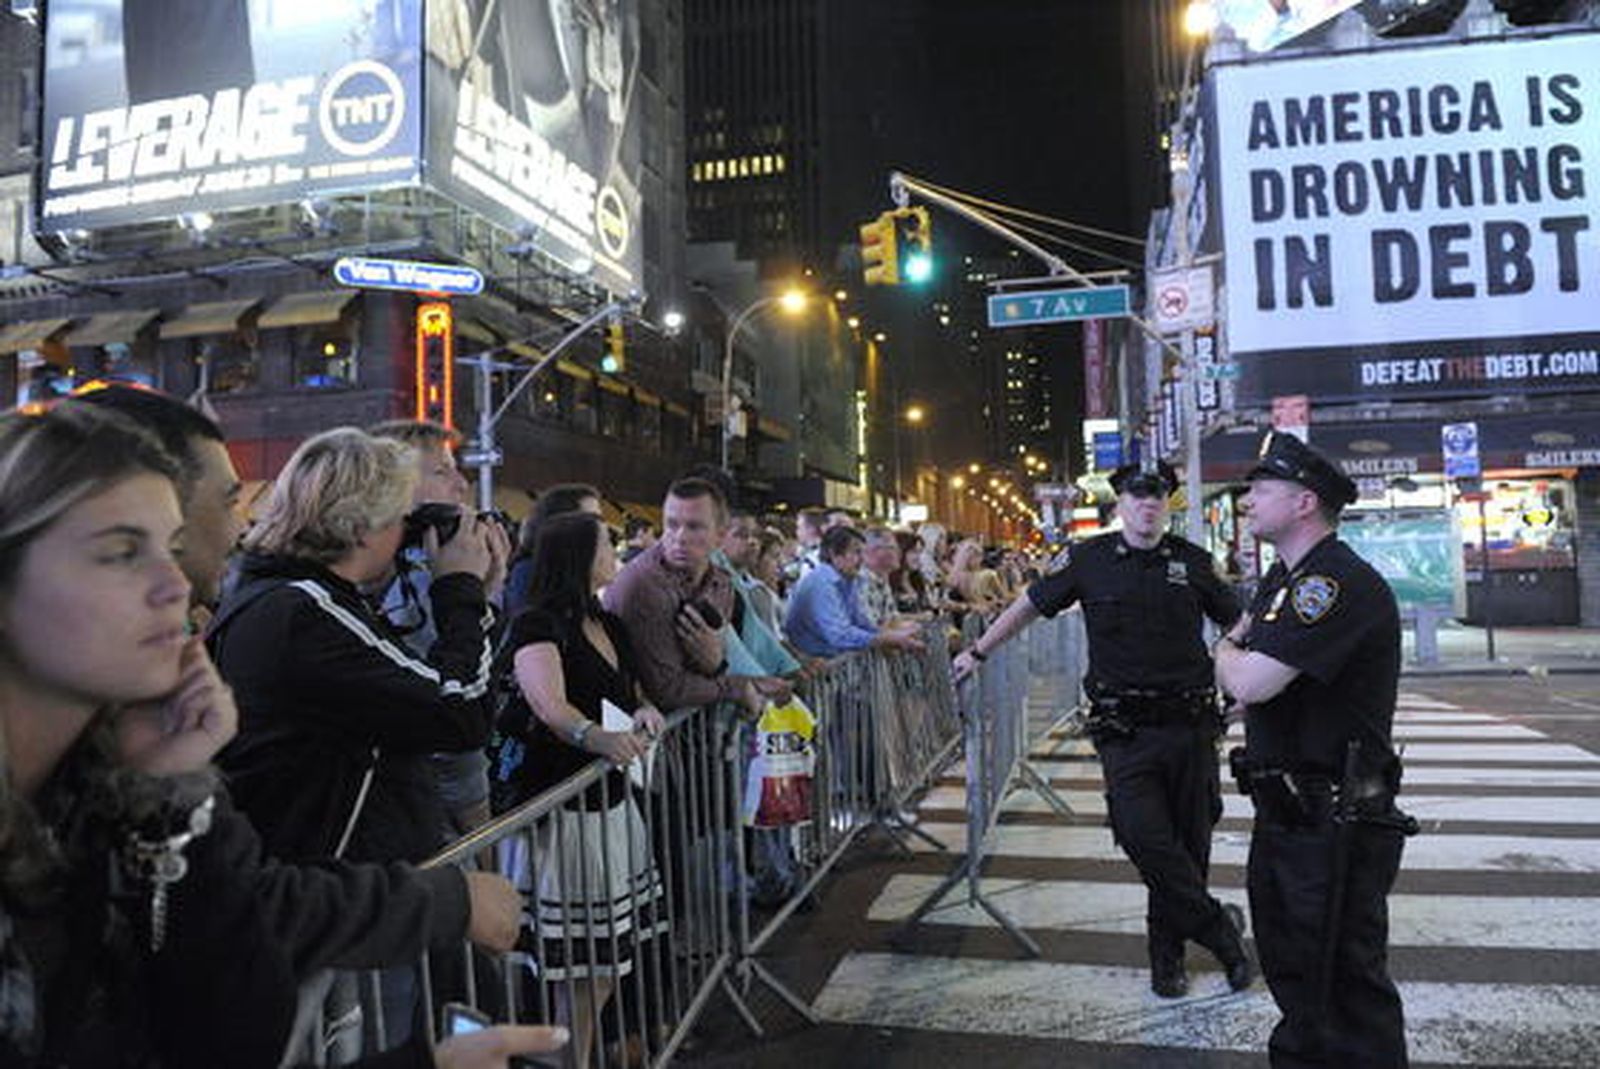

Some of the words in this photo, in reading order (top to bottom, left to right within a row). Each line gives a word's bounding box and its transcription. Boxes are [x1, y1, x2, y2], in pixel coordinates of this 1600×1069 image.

[49, 75, 314, 190] LEVERAGE
[332, 93, 393, 126] TNT
[1248, 80, 1503, 151] AMERICA
[1525, 73, 1583, 127] IS
[1250, 144, 1585, 223] DROWNING
[1253, 233, 1334, 311] IN
[1370, 214, 1590, 304] DEBT
[1029, 298, 1044, 315] 7
[1361, 350, 1598, 385] DEFEATTHEDEBT.COM
